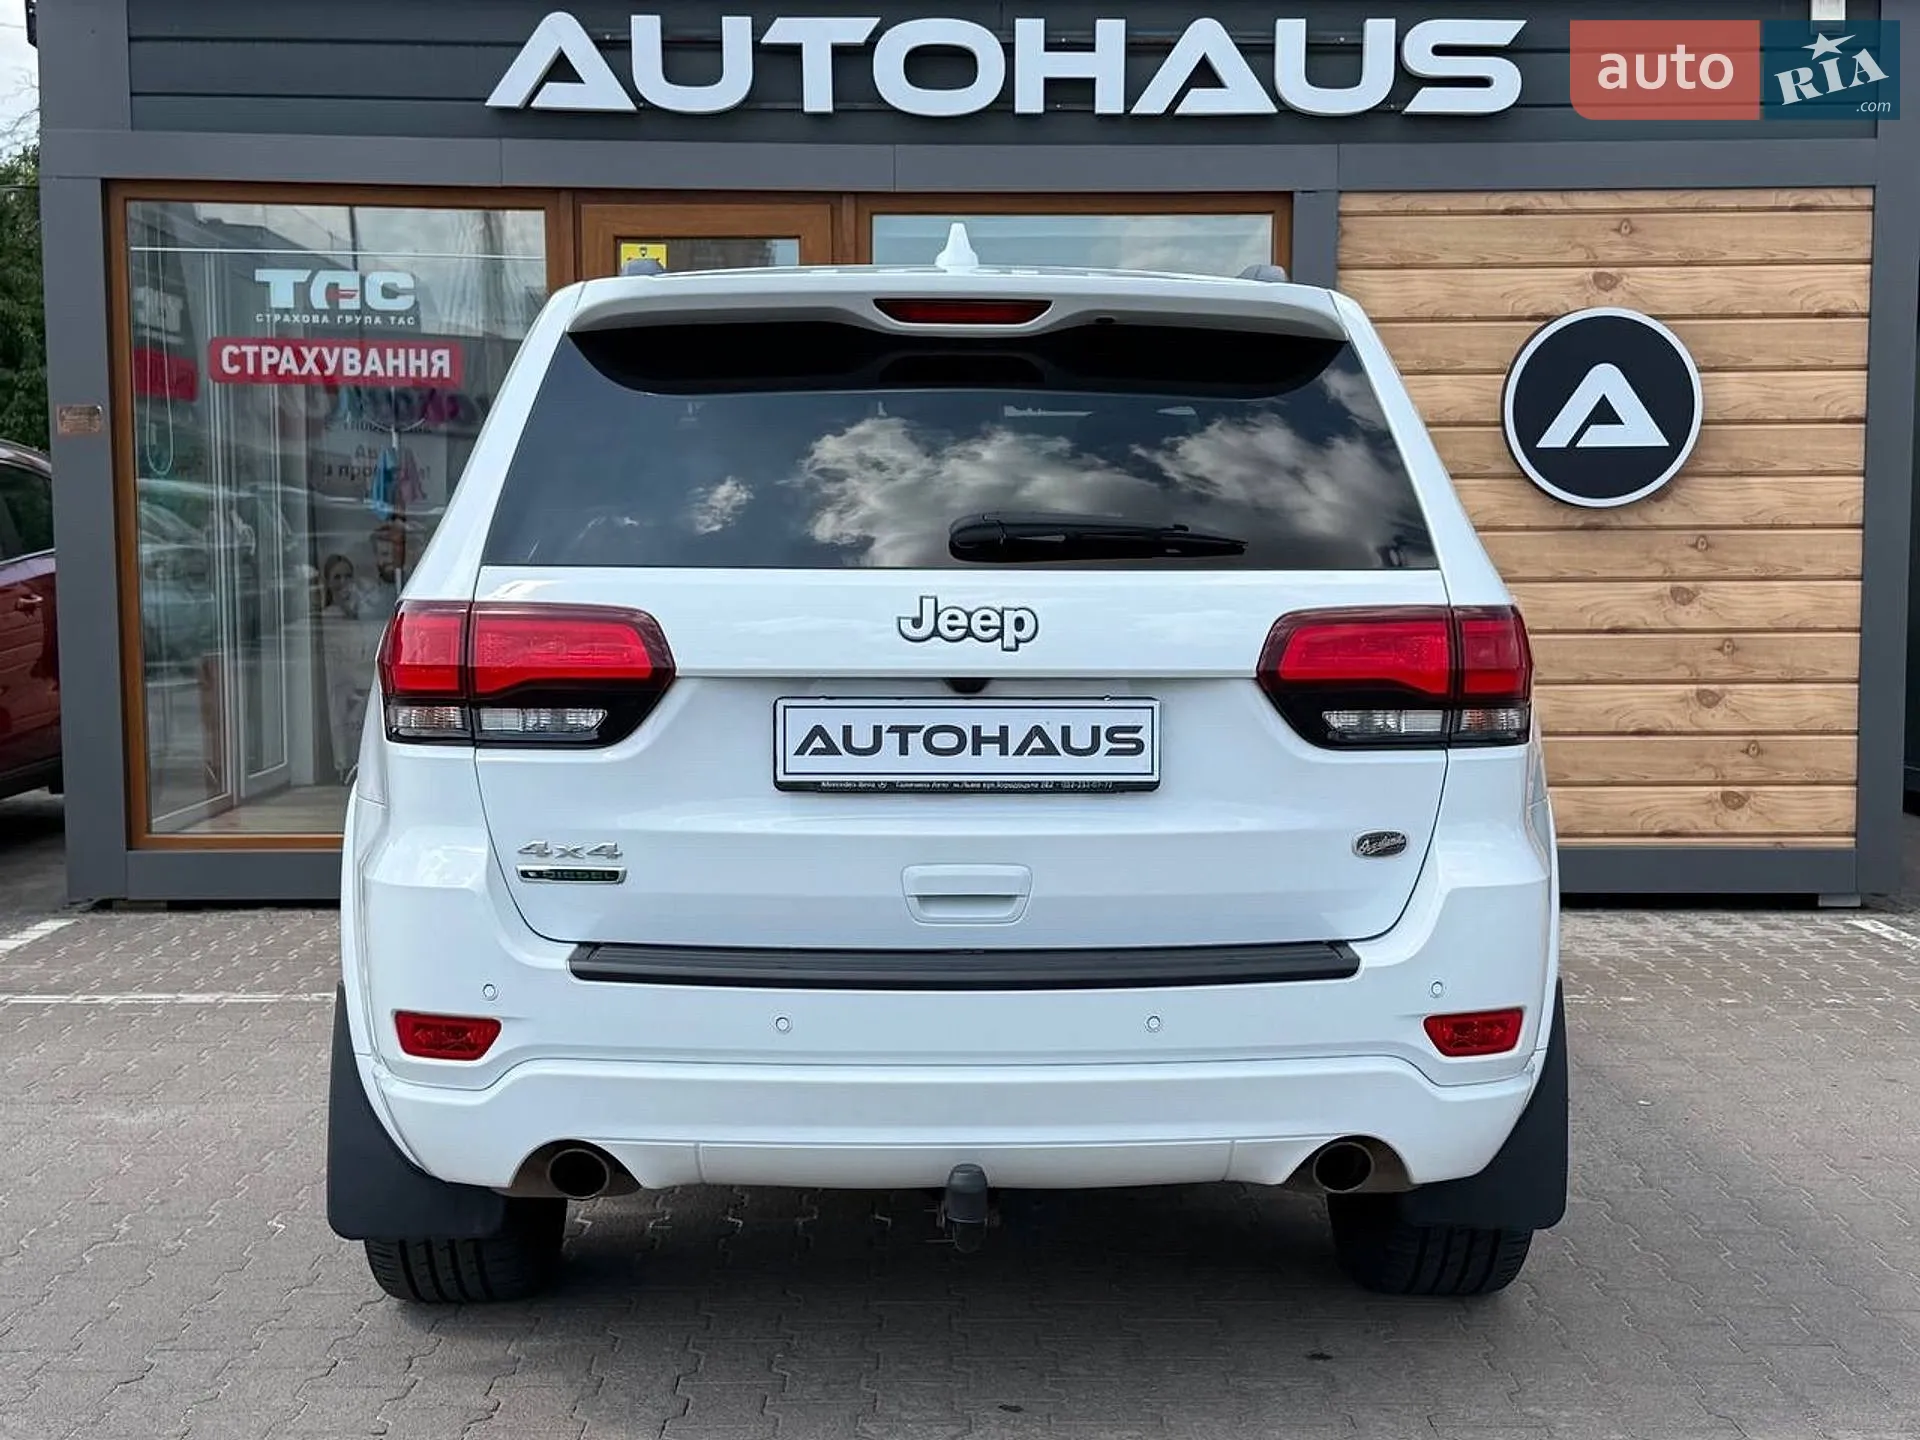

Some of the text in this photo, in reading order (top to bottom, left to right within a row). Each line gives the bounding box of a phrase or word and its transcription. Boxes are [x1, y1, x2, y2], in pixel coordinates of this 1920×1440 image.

[485, 11, 1527, 117] AUTOHAUS
[255, 313, 416, 326] СТРАХОВА ГРУПА ТАС
[220, 345, 451, 379] СТРАХУВАННЯ
[897, 595, 1039, 652] Jeep
[793, 724, 1145, 757] AUTOHAUS
